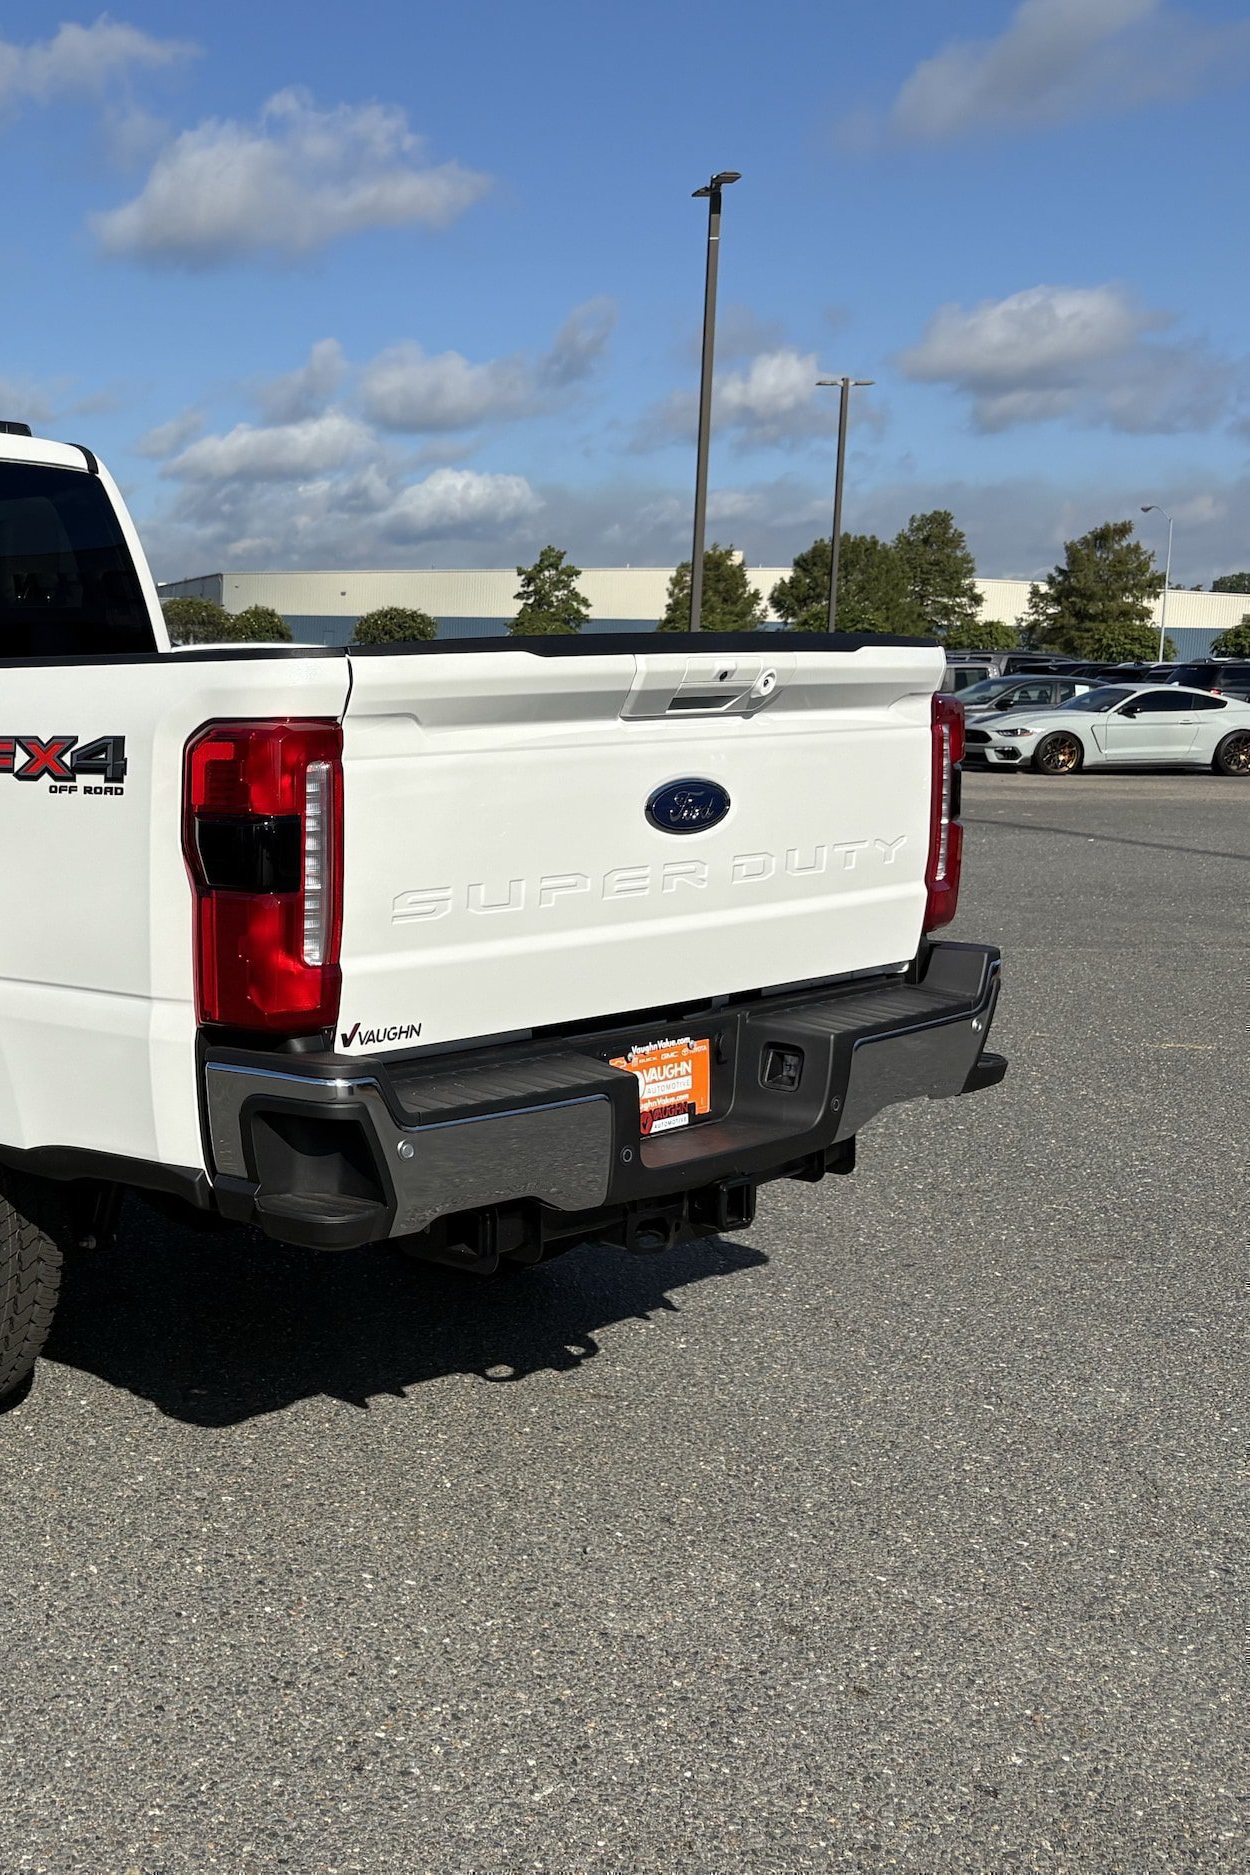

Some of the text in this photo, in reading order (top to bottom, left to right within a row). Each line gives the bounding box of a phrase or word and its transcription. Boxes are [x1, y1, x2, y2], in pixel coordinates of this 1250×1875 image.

[48, 784, 124, 796] OFF ROAD
[669, 790, 715, 823] Ford
[391, 835, 908, 926] SUPER DUTY
[358, 1022, 422, 1046] VAUGHN
[631, 1037, 691, 1055] VaughnValue.com
[643, 1060, 692, 1082] VAUGHN
[647, 1078, 691, 1094] AUTOMOTIVE
[652, 1101, 689, 1120] VAUGHN
[654, 1116, 687, 1129] AUTOMOTIVE
